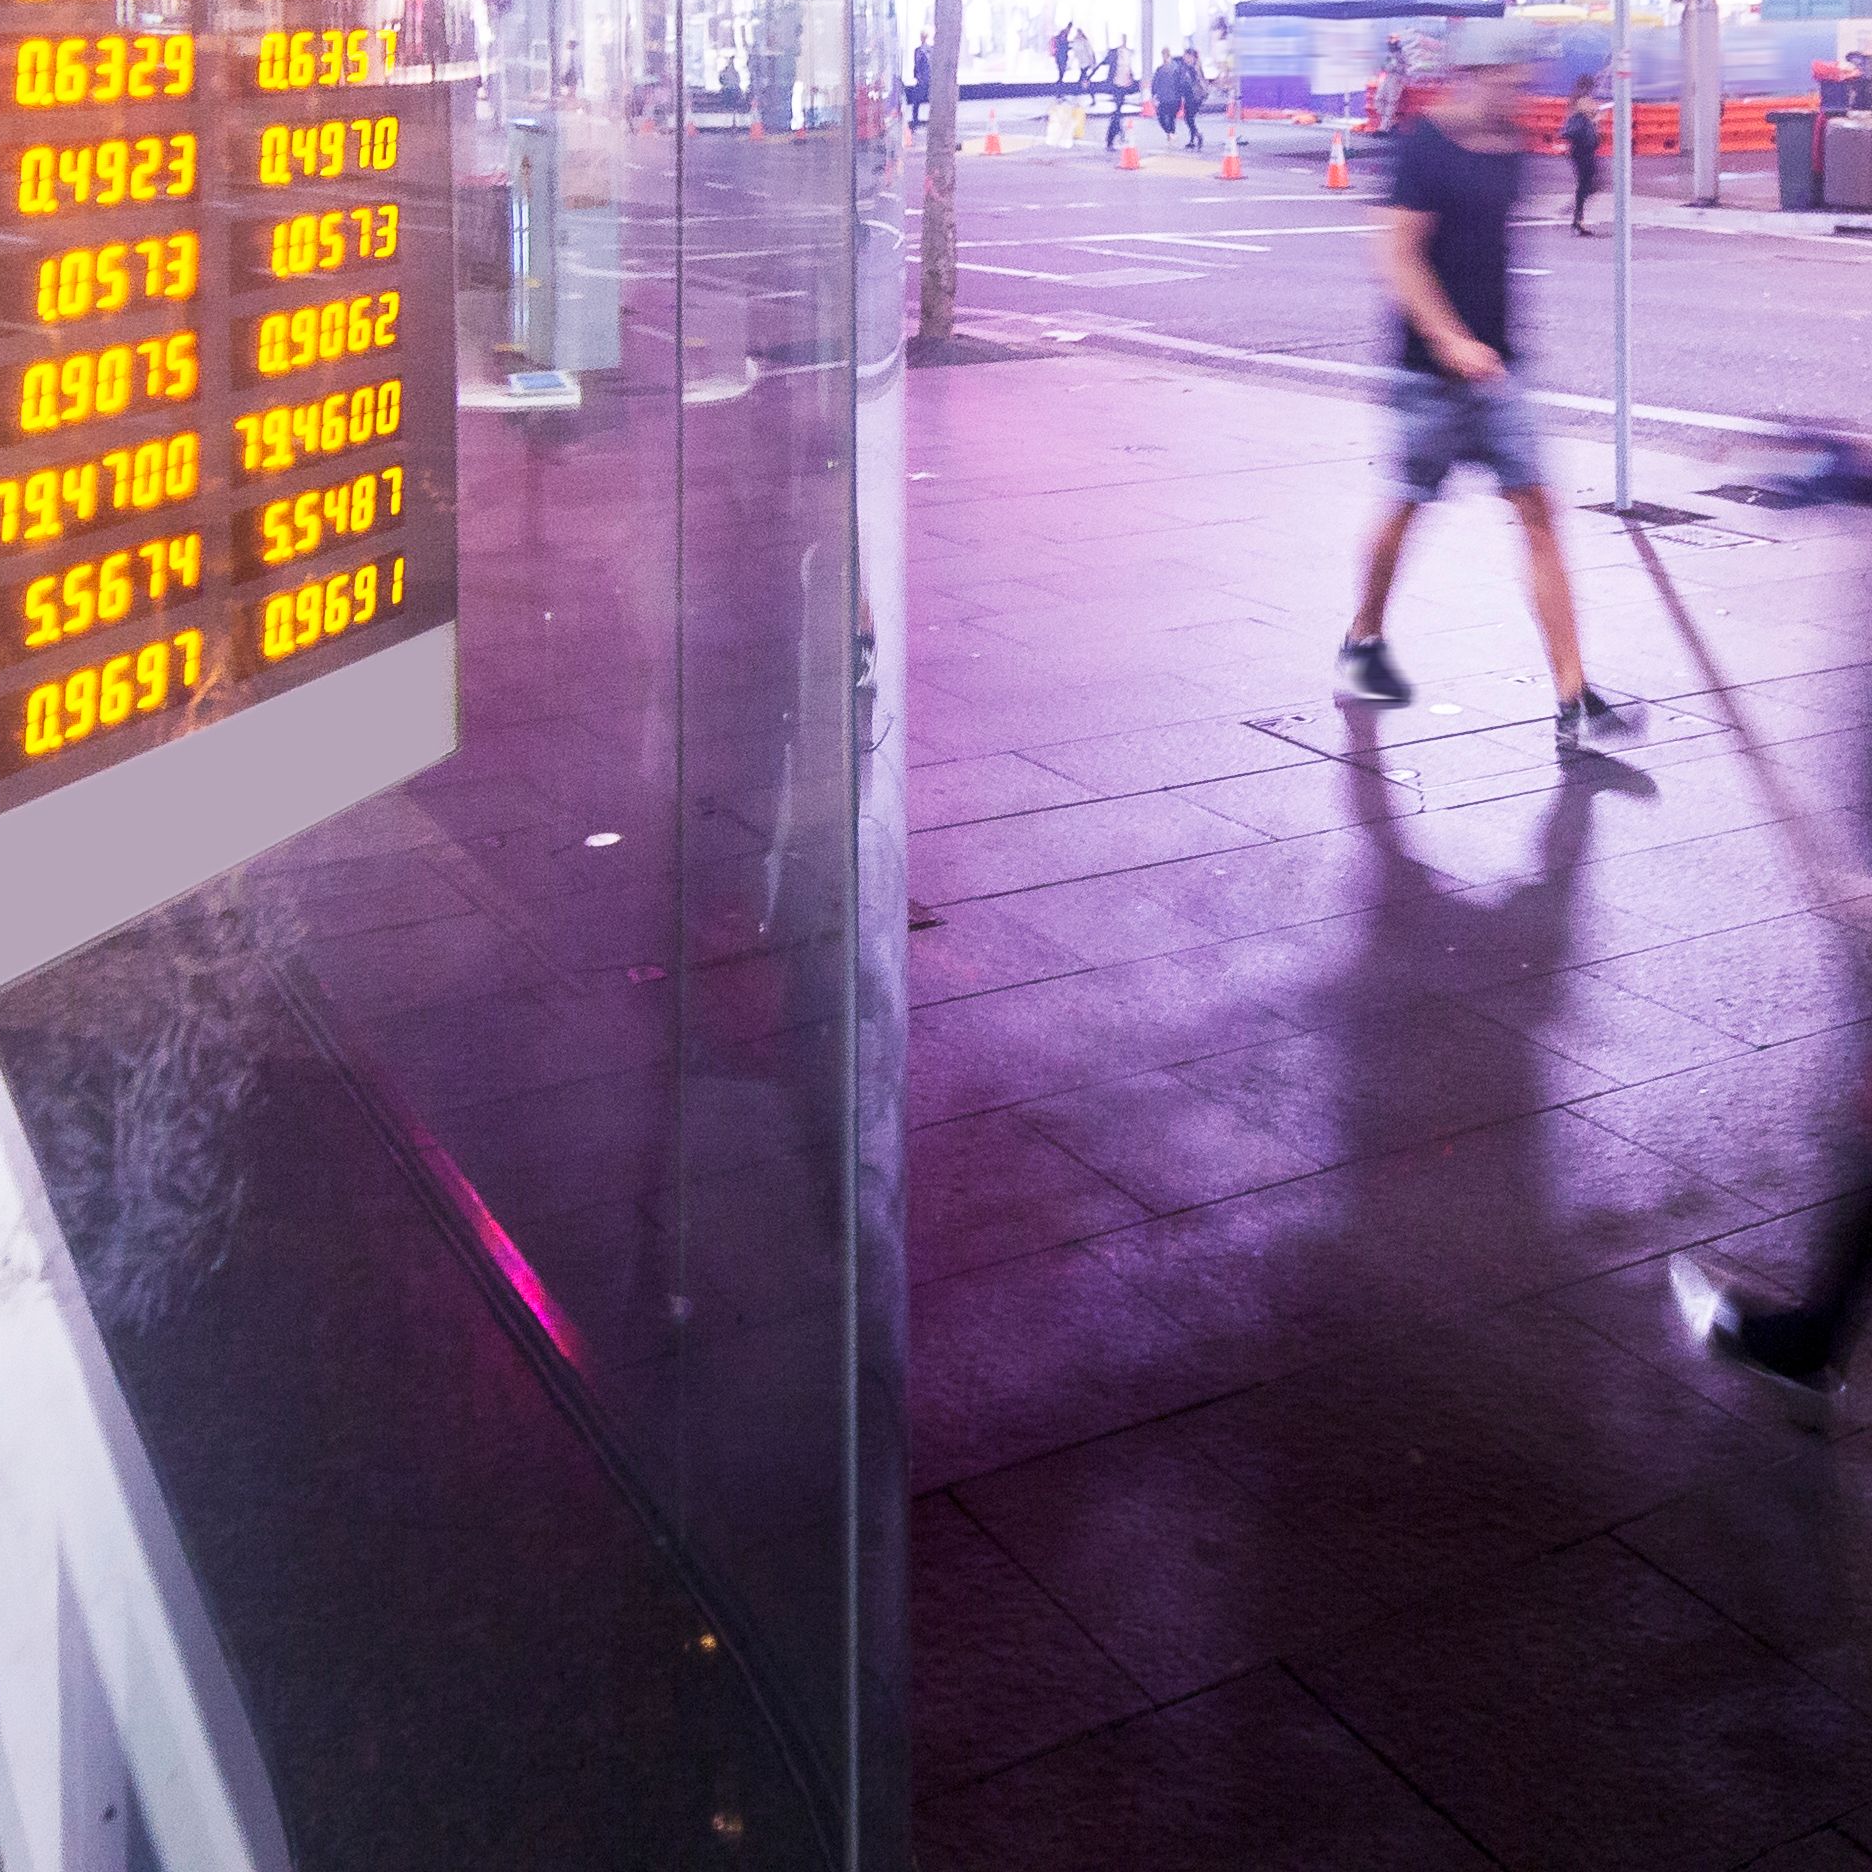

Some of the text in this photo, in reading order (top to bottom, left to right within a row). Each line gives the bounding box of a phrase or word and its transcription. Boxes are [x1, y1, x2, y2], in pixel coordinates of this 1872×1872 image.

[14, 31, 196, 108] 0.6329
[257, 28, 398, 91] 0.6357
[17, 133, 197, 215] 0.4923
[258, 115, 399, 187] 0.4970
[36, 234, 198, 323] 1.0573
[270, 203, 400, 279] 1.0573
[19, 332, 197, 433] 0.9075
[257, 290, 401, 375] 0.9062
[233, 379, 402, 471] 79.4600
[24, 533, 199, 647] 5.5674
[262, 466, 403, 563] 5.5487
[23, 629, 202, 756] 0.9697
[262, 556, 405, 659] 0.9691
